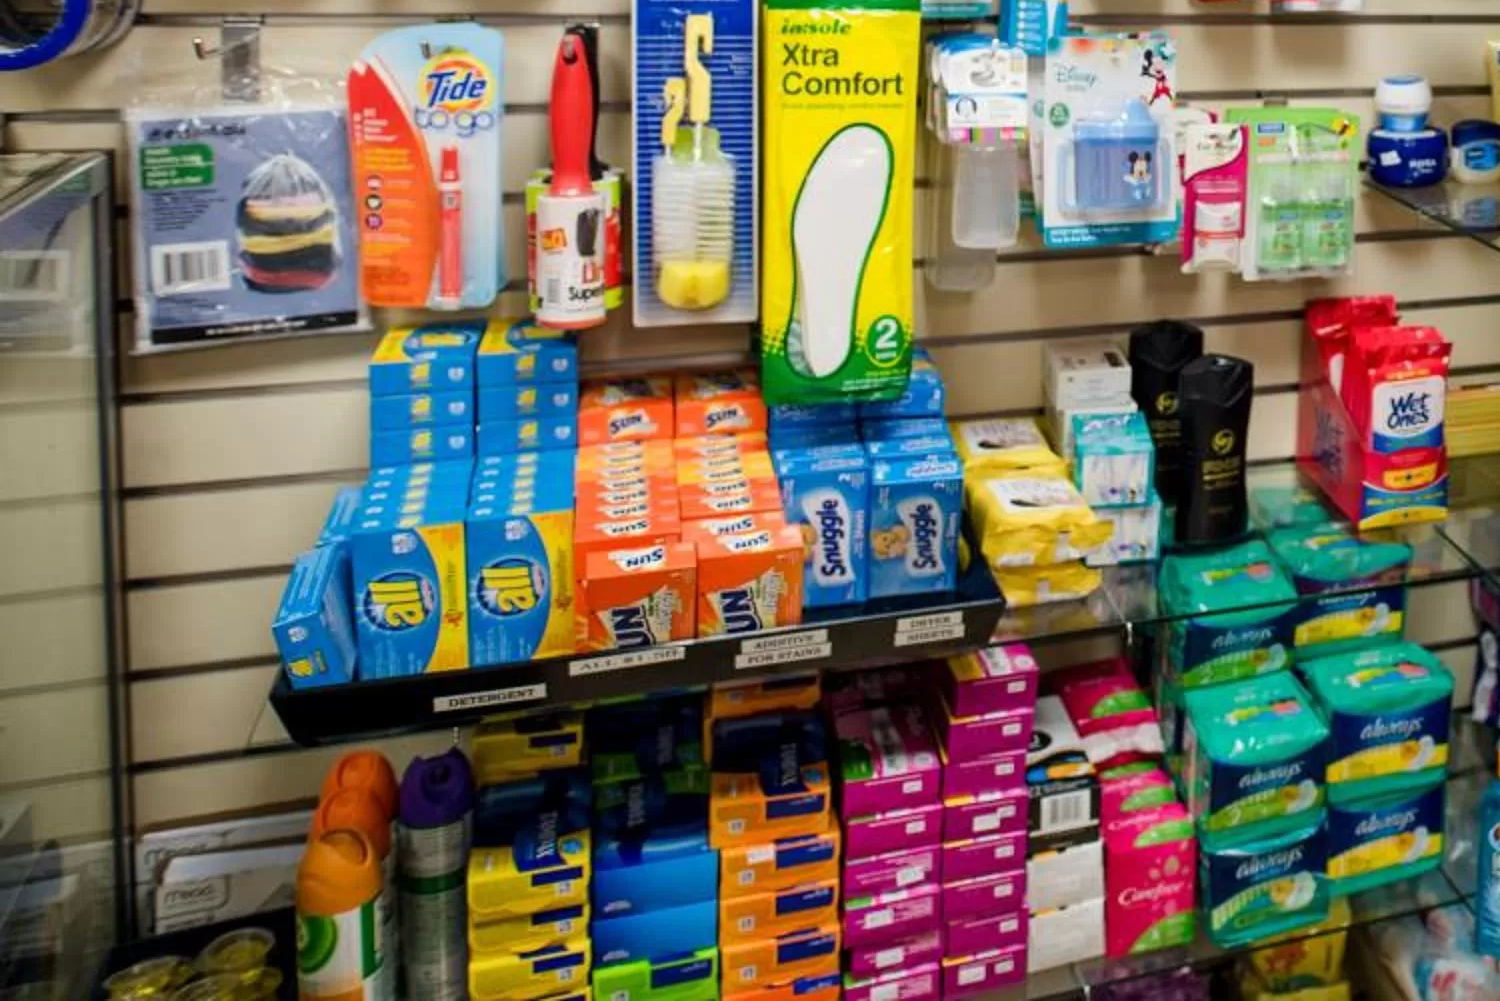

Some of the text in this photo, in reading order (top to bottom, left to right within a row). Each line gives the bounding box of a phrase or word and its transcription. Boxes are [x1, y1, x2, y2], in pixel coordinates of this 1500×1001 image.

[783, 45, 839, 68] Xtra
[428, 71, 488, 108] Tide
[781, 71, 904, 97] Comfort
[874, 317, 898, 350] 2
[1389, 390, 1432, 415] Wet
[609, 412, 644, 435] SUN
[705, 405, 739, 428] SUN
[1387, 410, 1431, 430] Ones
[821, 498, 849, 577] Snuggle
[912, 502, 938, 570] Snuggle
[722, 586, 760, 633] UN
[613, 605, 649, 649] UN
[448, 687, 536, 709] DETERGENT
[1360, 715, 1425, 740] always
[1239, 762, 1304, 789] always
[1354, 808, 1419, 837] always
[1235, 847, 1304, 880] always
[1116, 879, 1184, 906] Carefree
